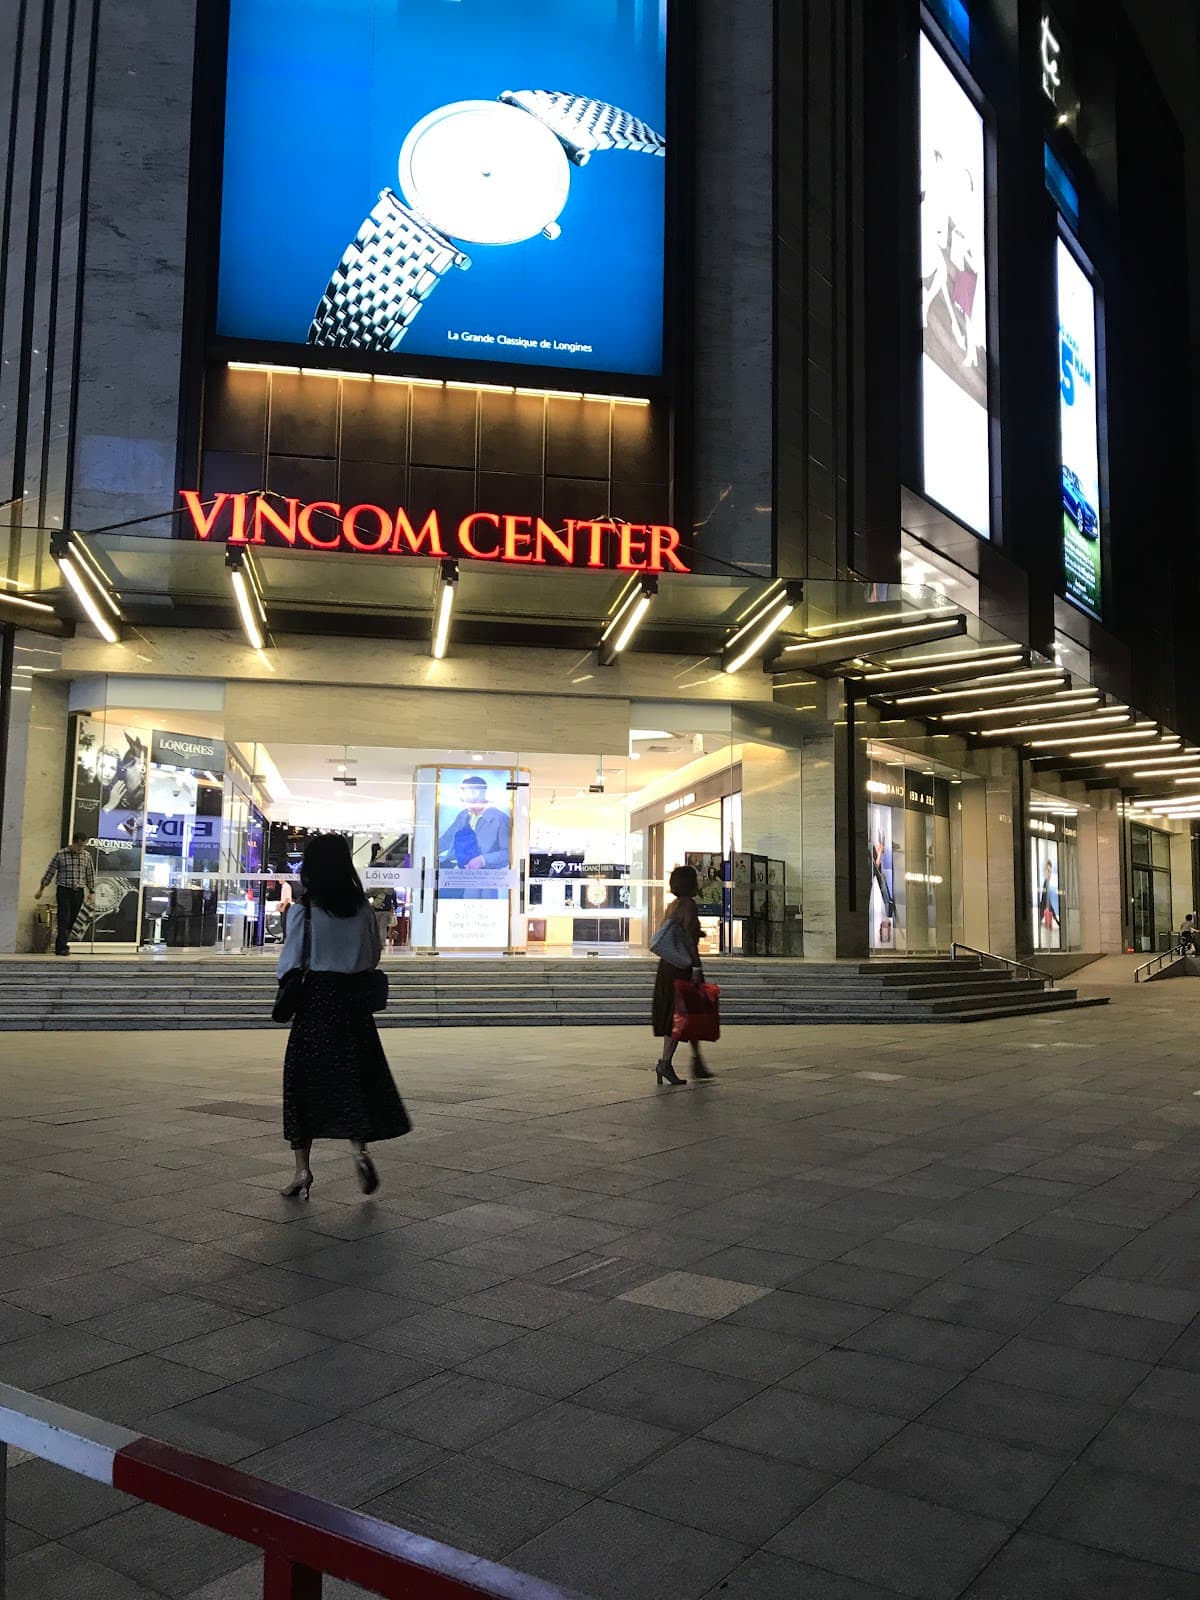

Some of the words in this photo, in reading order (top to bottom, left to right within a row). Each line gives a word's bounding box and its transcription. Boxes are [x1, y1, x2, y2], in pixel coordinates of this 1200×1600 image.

[447, 330, 459, 340] La
[461, 331, 495, 344] Grande
[496, 335, 538, 349] Classique
[539, 339, 551, 349] de
[553, 340, 593, 353] Longines
[179, 490, 447, 555] VINCOM
[457, 511, 691, 573] CENTER
[159, 739, 215, 756] LONGINES
[84, 837, 133, 850] ONGINES
